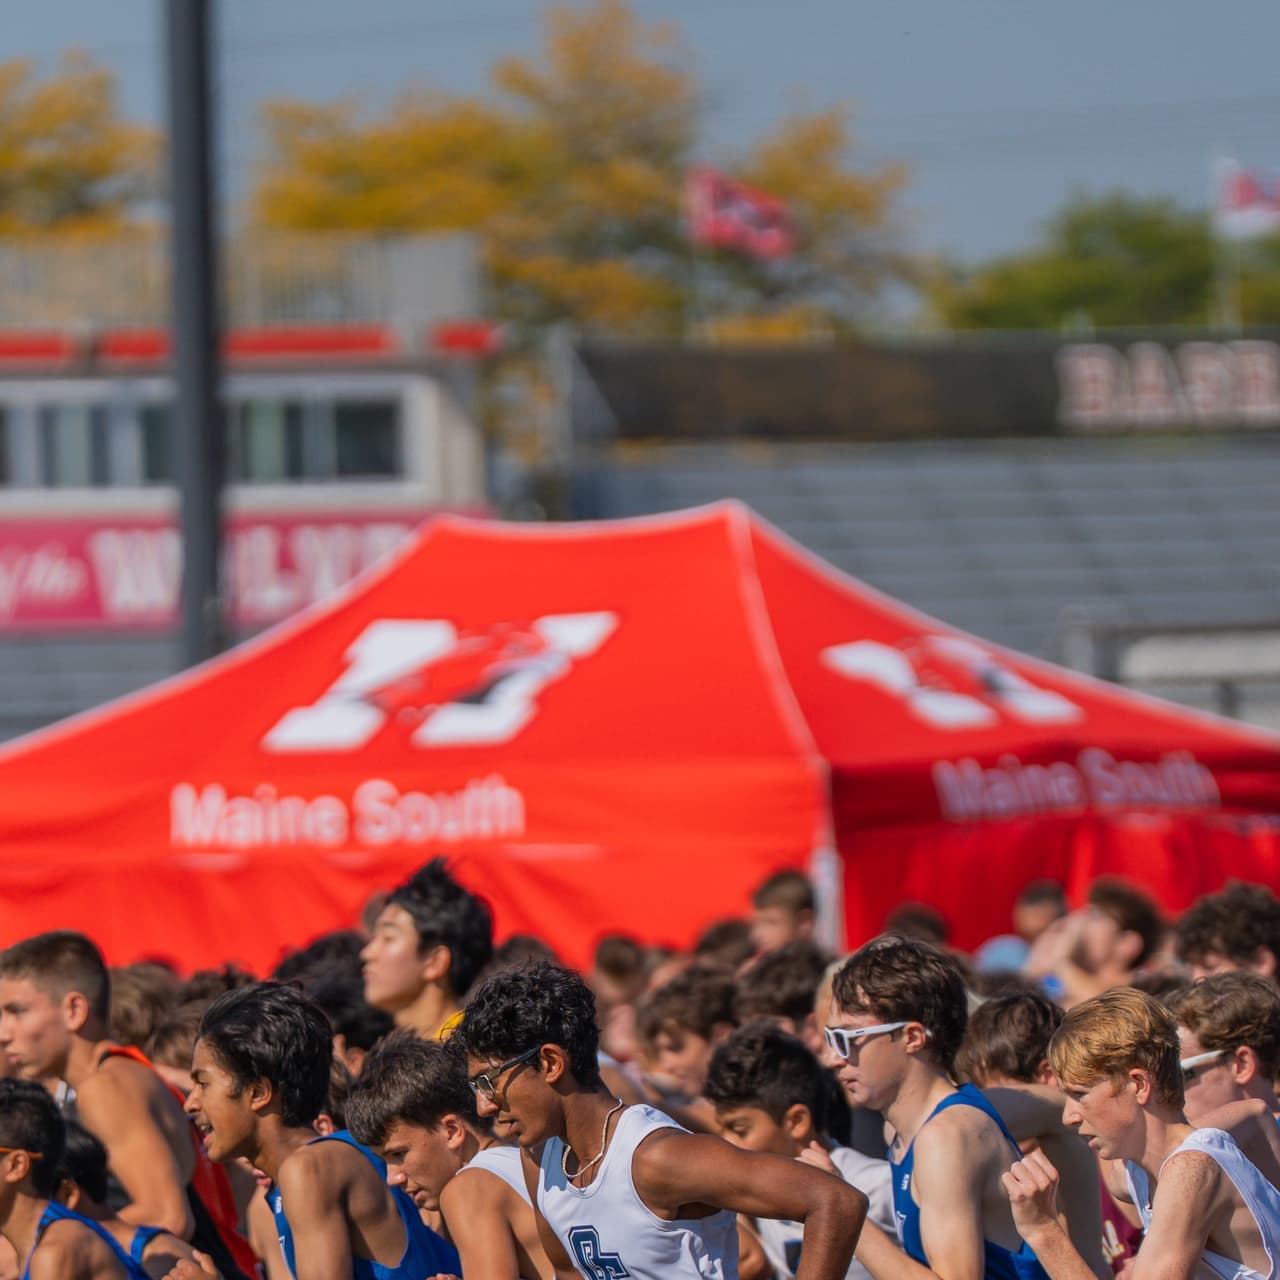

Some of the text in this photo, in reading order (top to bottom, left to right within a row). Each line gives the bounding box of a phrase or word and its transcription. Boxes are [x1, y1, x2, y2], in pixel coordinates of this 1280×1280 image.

[170, 774, 526, 846] Maine South
[932, 747, 1221, 822] Maine South
